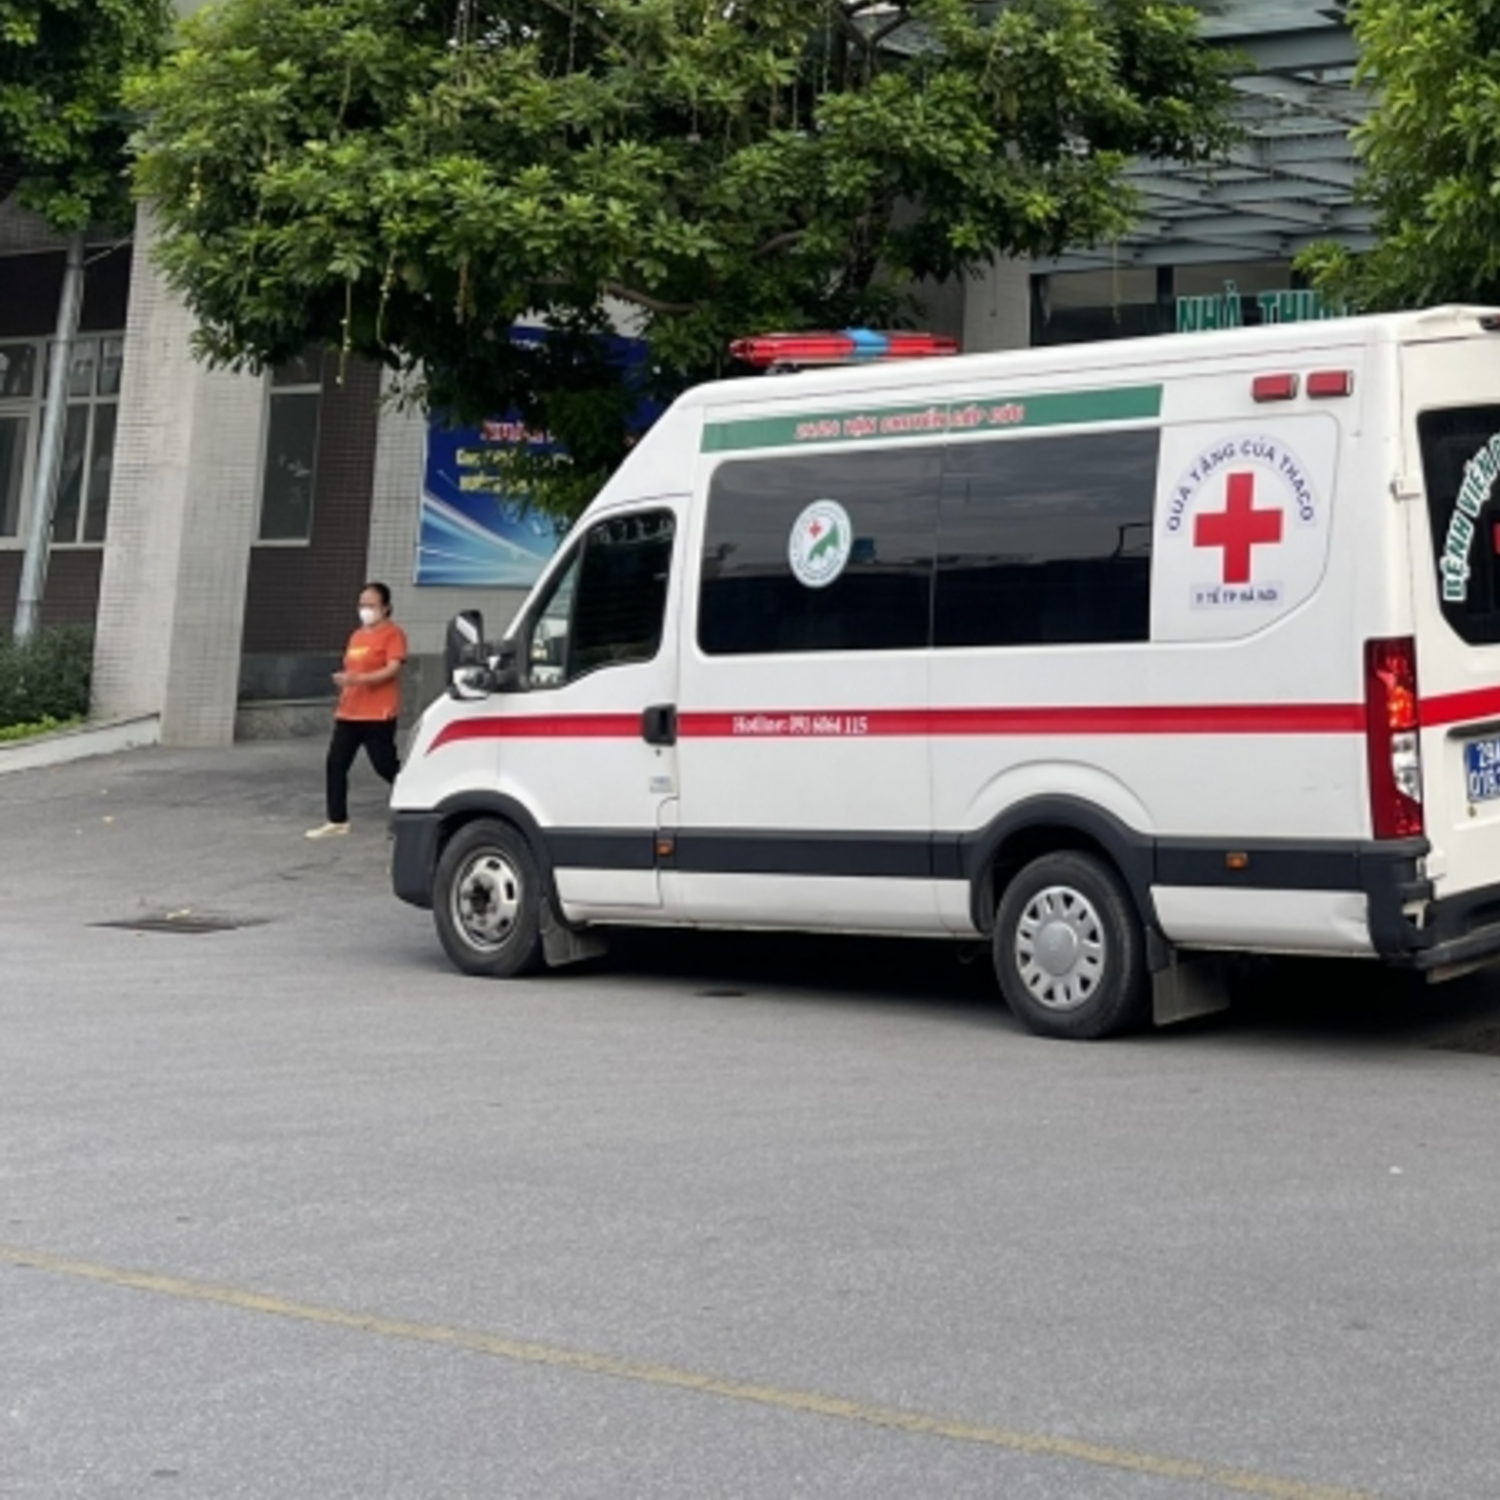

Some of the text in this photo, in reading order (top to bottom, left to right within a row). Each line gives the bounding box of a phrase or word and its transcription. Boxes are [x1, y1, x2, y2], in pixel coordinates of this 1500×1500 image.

[1278, 453, 1314, 521] THACO
[1456, 446, 1499, 519] VIỆN
[1440, 510, 1475, 601] BỆNH
